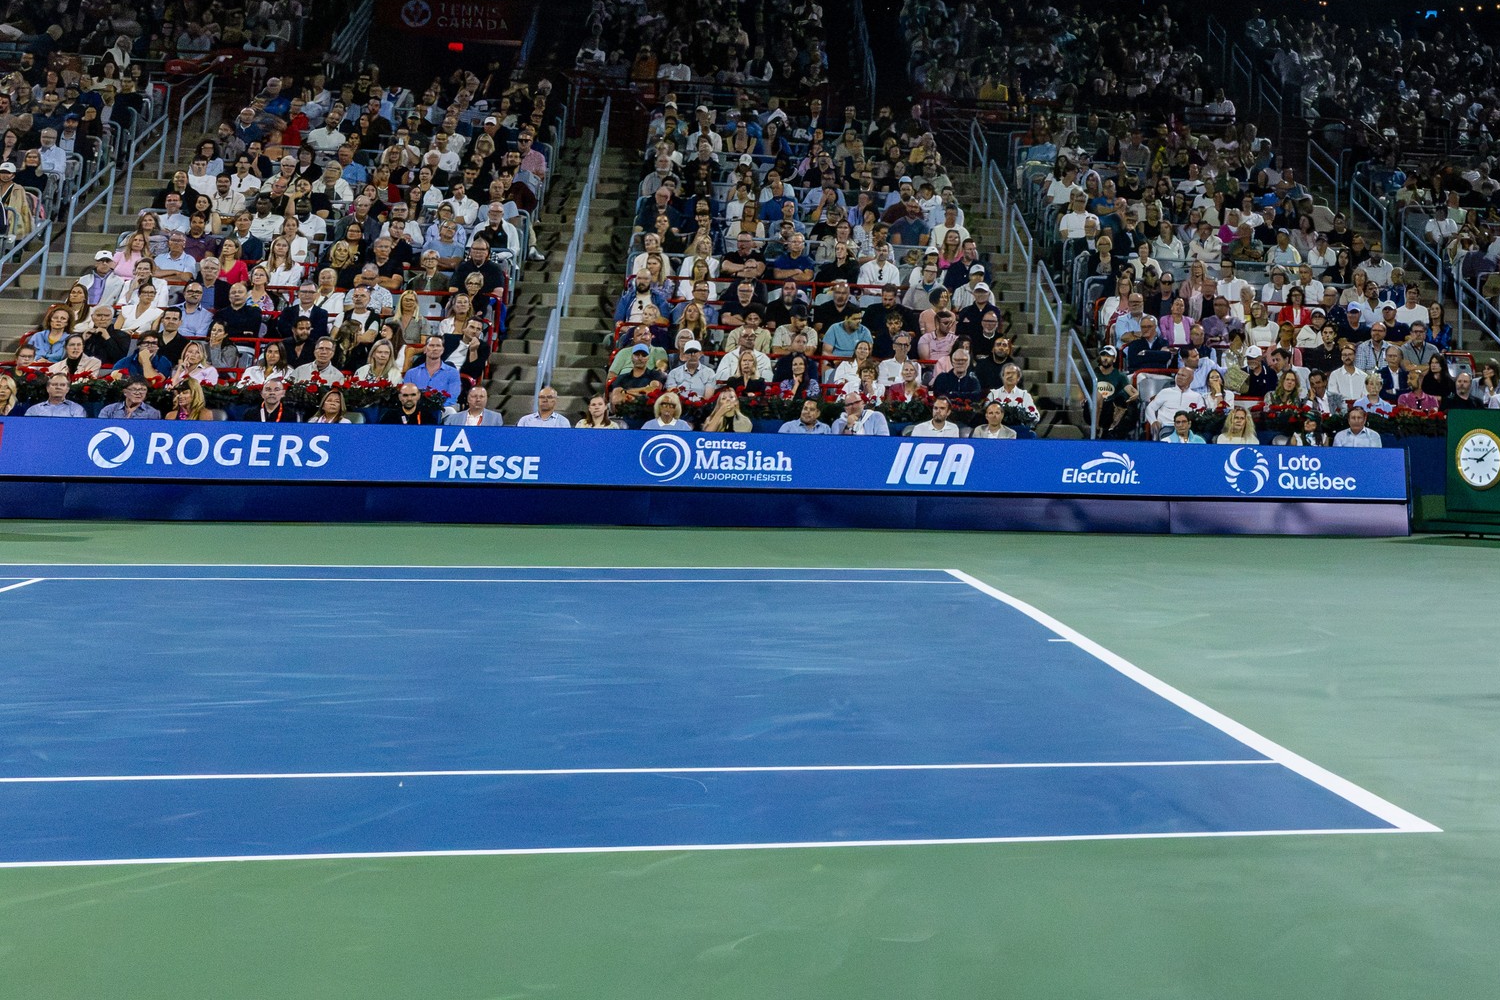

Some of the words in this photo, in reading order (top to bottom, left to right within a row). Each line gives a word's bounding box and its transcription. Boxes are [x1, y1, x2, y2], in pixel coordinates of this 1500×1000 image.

[437, 16, 508, 31] CANADA
[146, 432, 330, 468] ROGERS
[433, 428, 472, 452] LA
[696, 437, 747, 450] Centres
[430, 454, 541, 481] PRESSE
[694, 449, 793, 472] Masliah
[886, 442, 975, 486] IGA
[1278, 453, 1322, 472] Loto
[693, 472, 793, 482] AUDIOPROTHÉSISTES
[1278, 471, 1357, 491] Québec
